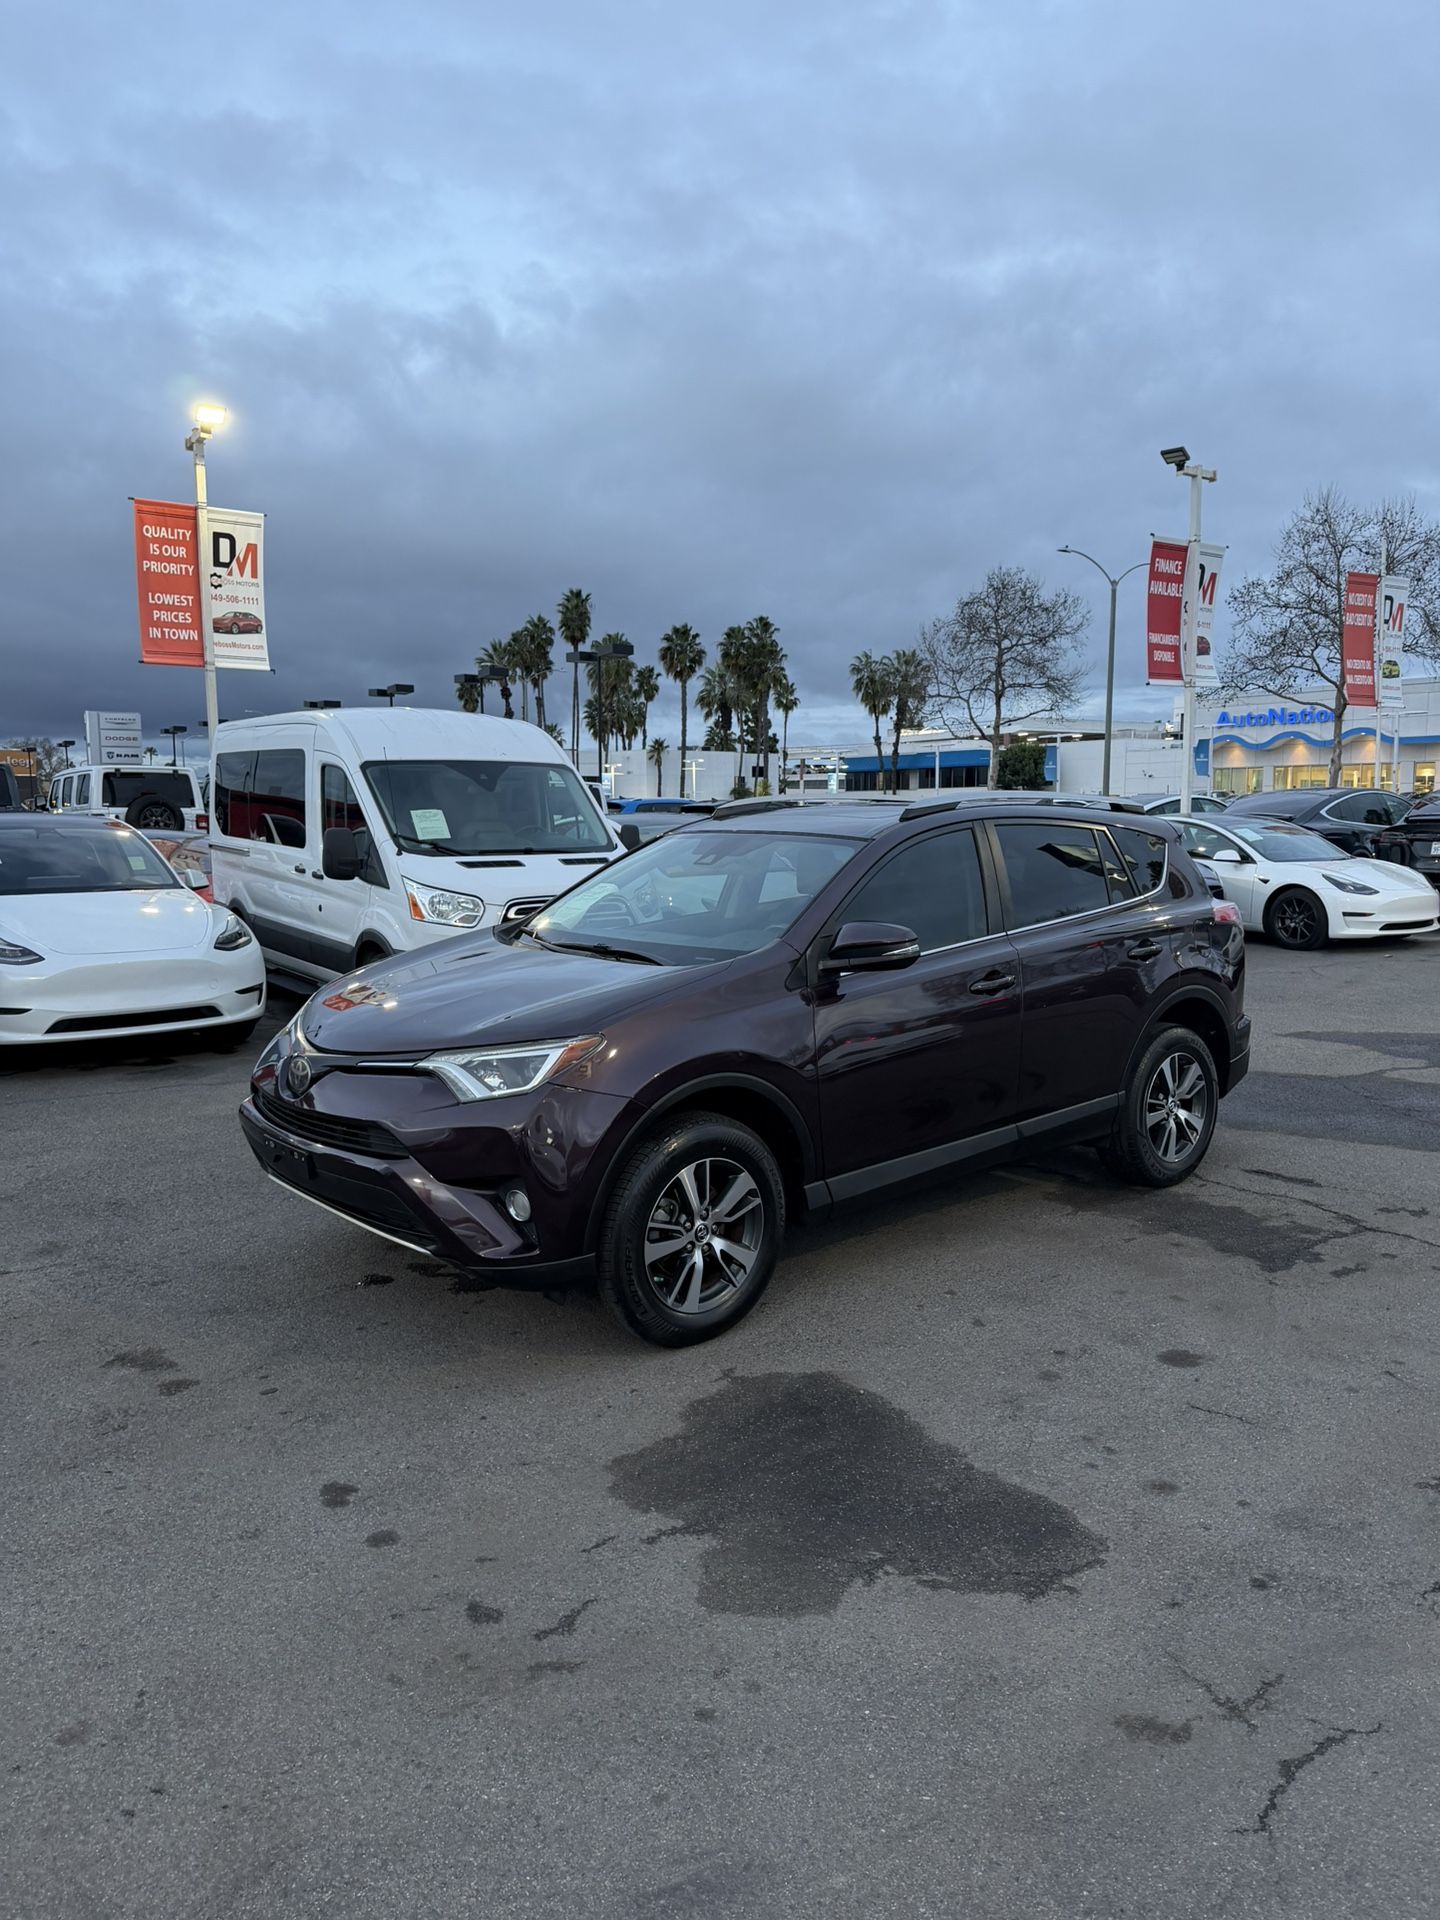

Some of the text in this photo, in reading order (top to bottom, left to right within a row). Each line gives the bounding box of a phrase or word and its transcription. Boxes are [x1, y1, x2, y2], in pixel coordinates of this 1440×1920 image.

[142, 525, 192, 541] QUALITY
[149, 543, 187, 558] IS OUR
[143, 560, 194, 576] PRIORITY
[1154, 558, 1182, 575] FINANCE
[1149, 580, 1183, 597] AVAILABLE
[148, 592, 194, 607] LOWEST
[153, 610, 192, 623] PRICES
[149, 627, 198, 640] IN TOWN
[6, 755, 34, 768] Jeep
